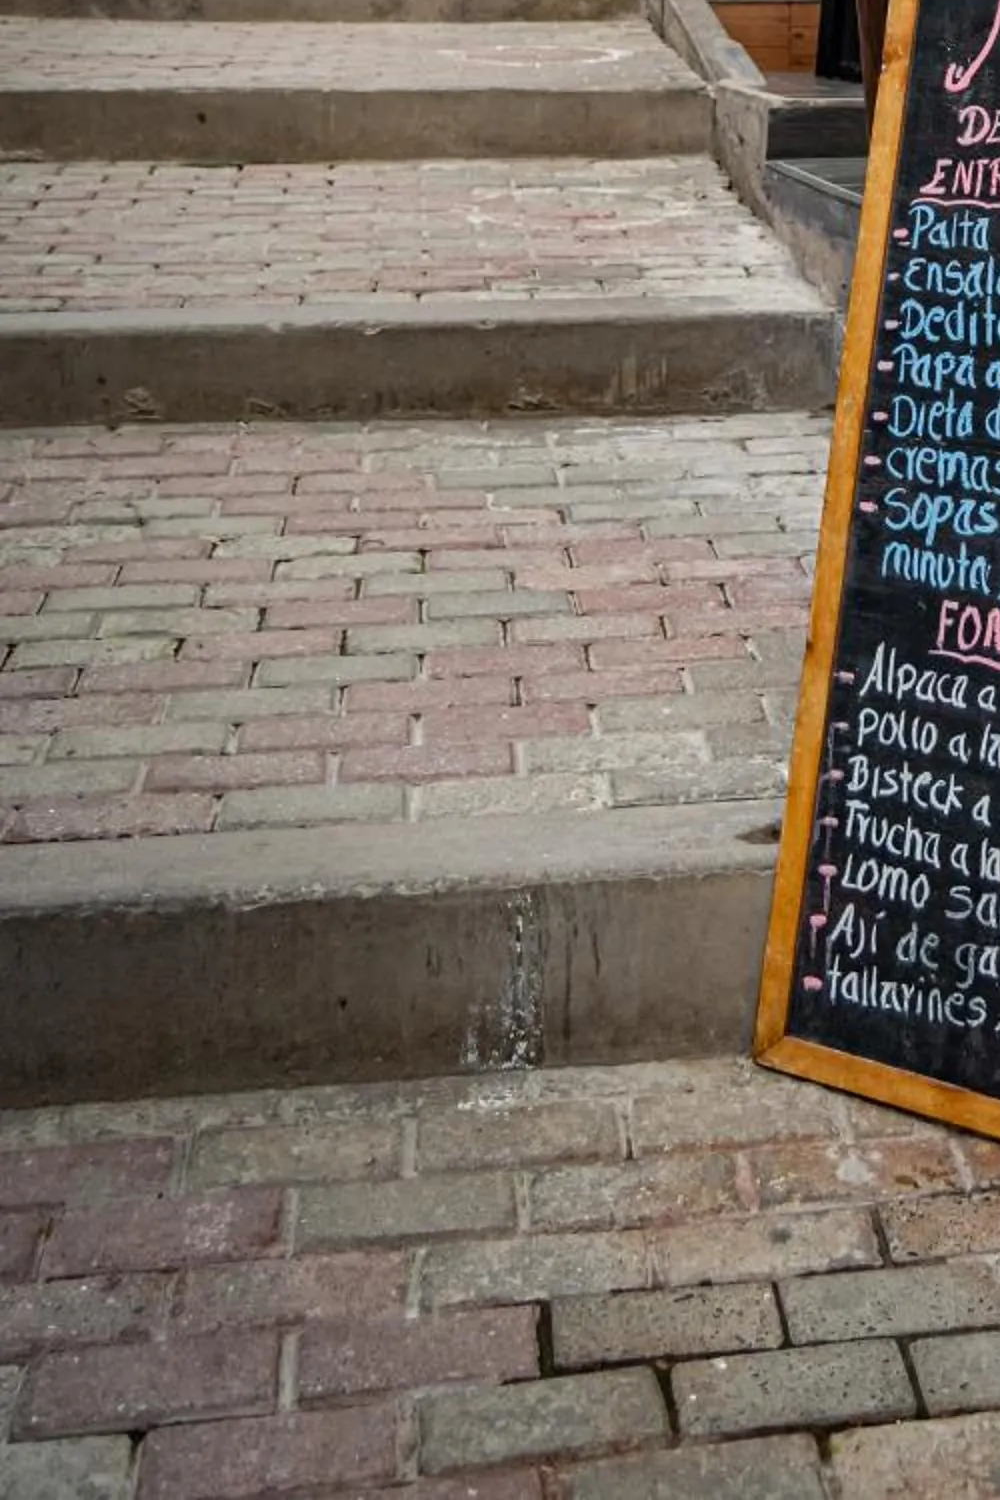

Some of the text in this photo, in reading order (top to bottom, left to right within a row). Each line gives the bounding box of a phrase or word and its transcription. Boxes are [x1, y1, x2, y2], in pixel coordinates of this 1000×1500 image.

[908, 205, 990, 251] Palta
[892, 342, 977, 394] Papa
[887, 395, 974, 442] Dieta
[859, 641, 968, 709] Alpaca
[977, 684, 996, 712] a
[949, 732, 970, 763] a
[847, 754, 964, 816] Bisteck
[972, 795, 991, 827] a
[845, 800, 941, 869] Trucha
[951, 843, 970, 876] a
[979, 838, 1000, 882] la
[896, 921, 940, 970] de
